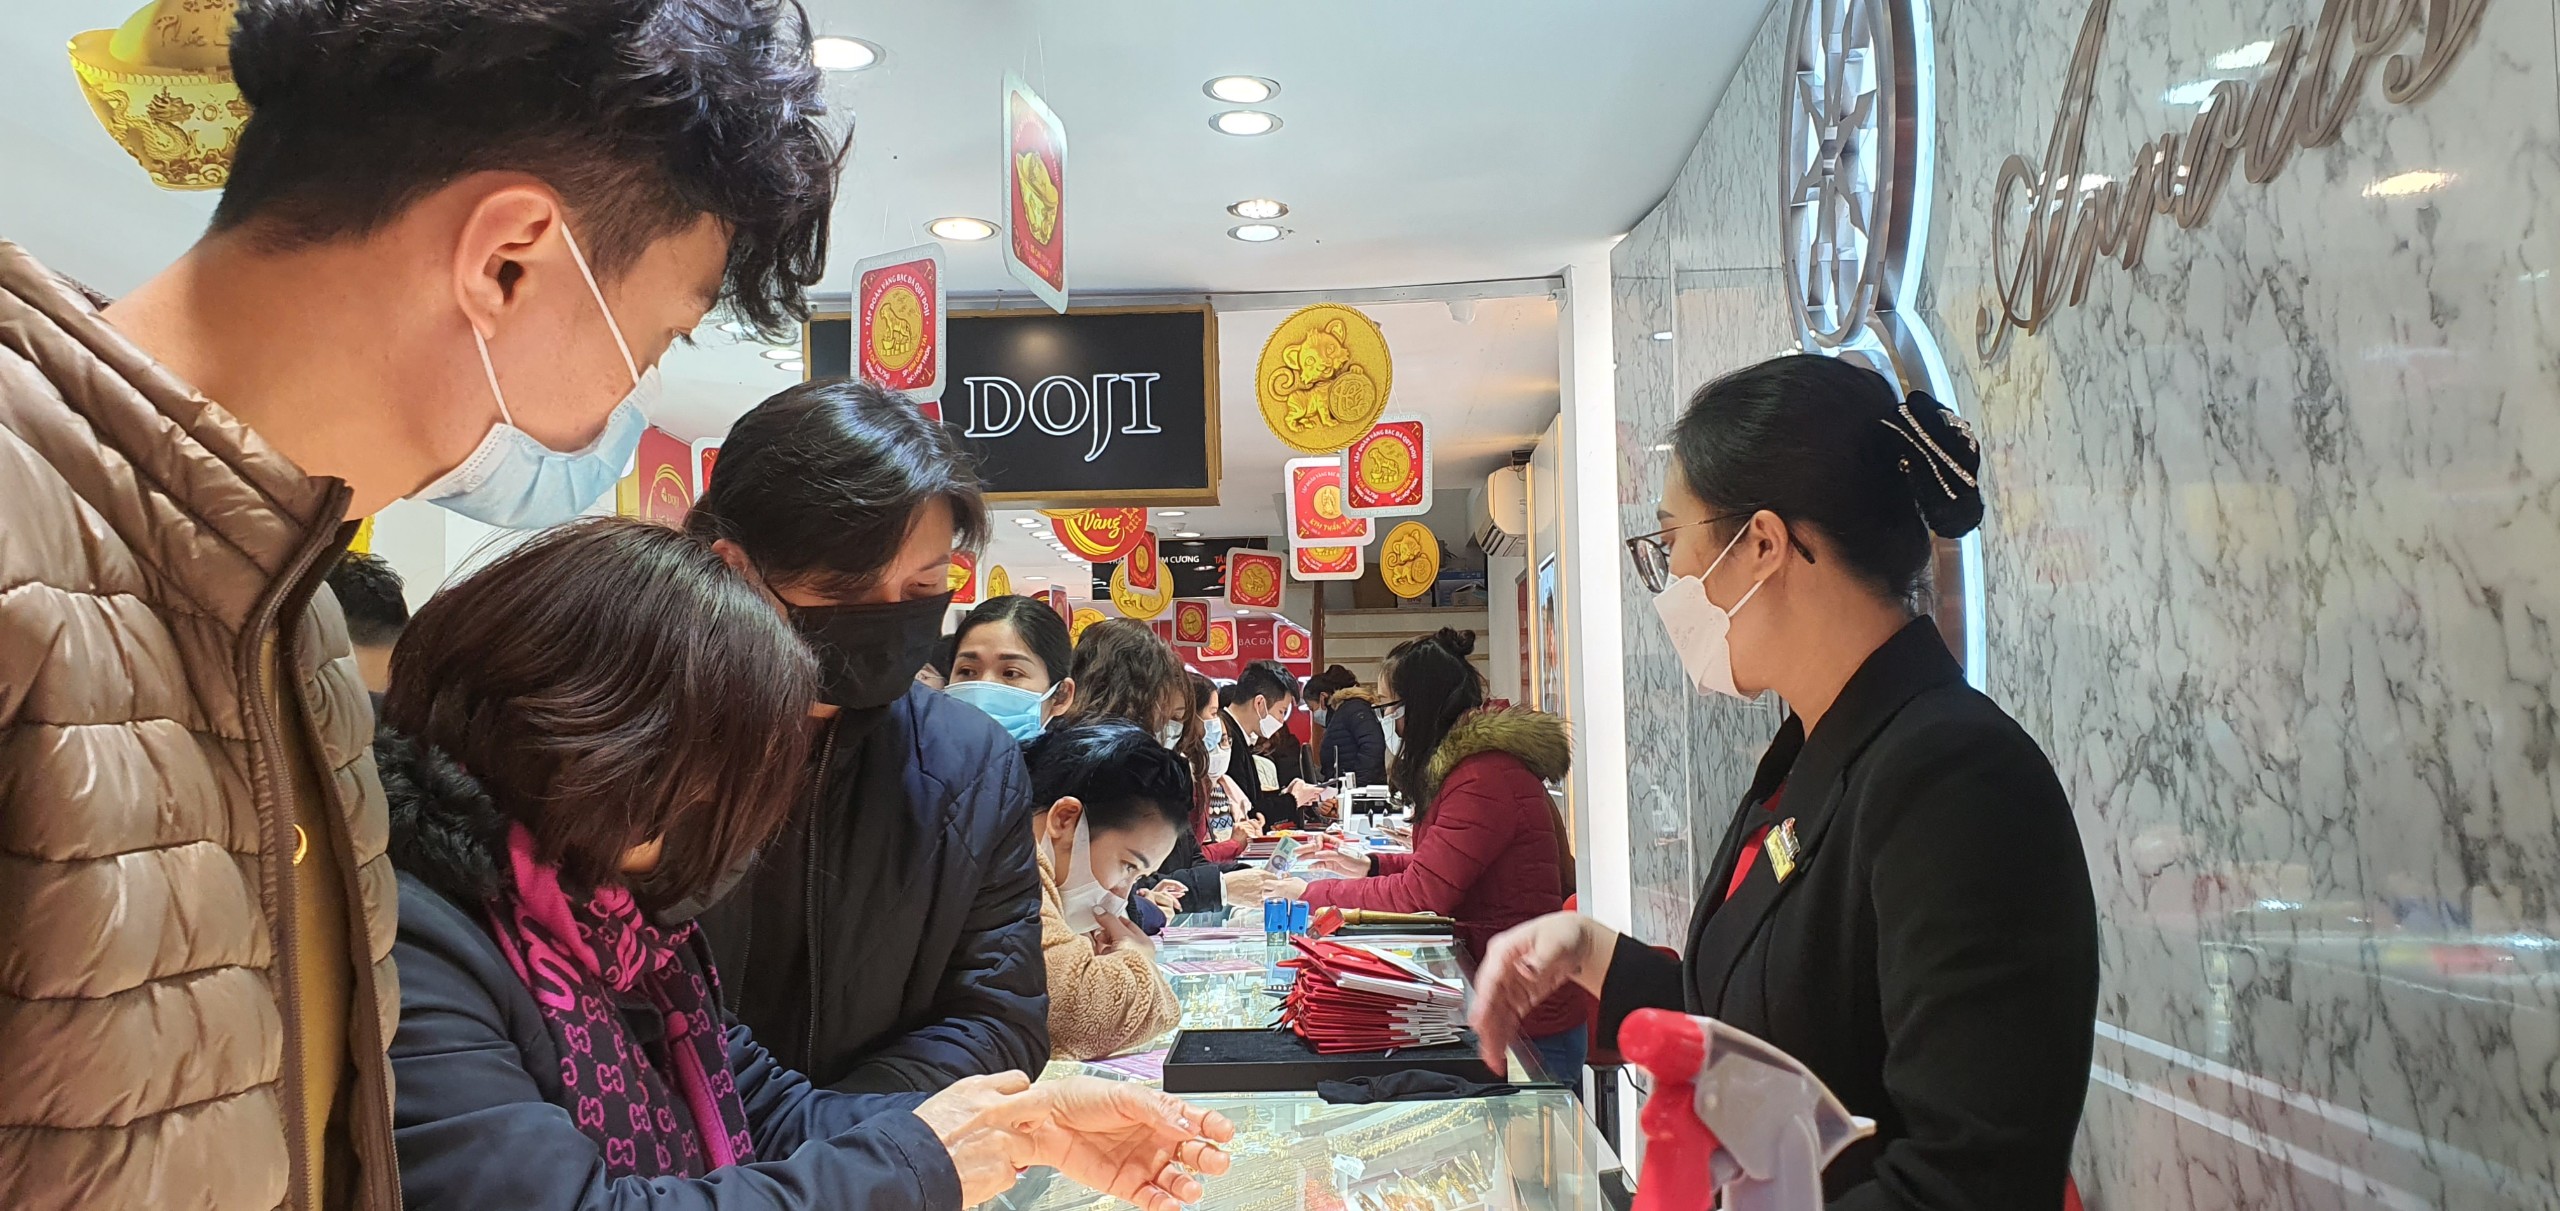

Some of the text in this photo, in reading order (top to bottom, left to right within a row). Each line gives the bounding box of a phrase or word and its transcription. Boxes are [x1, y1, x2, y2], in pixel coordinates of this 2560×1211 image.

[963, 372, 1162, 462] DOJI
[1078, 512, 1123, 538] Vàng
[1170, 555, 1200, 564] CƯƠNG
[1238, 635, 1274, 648] BẠC ĐÁ
